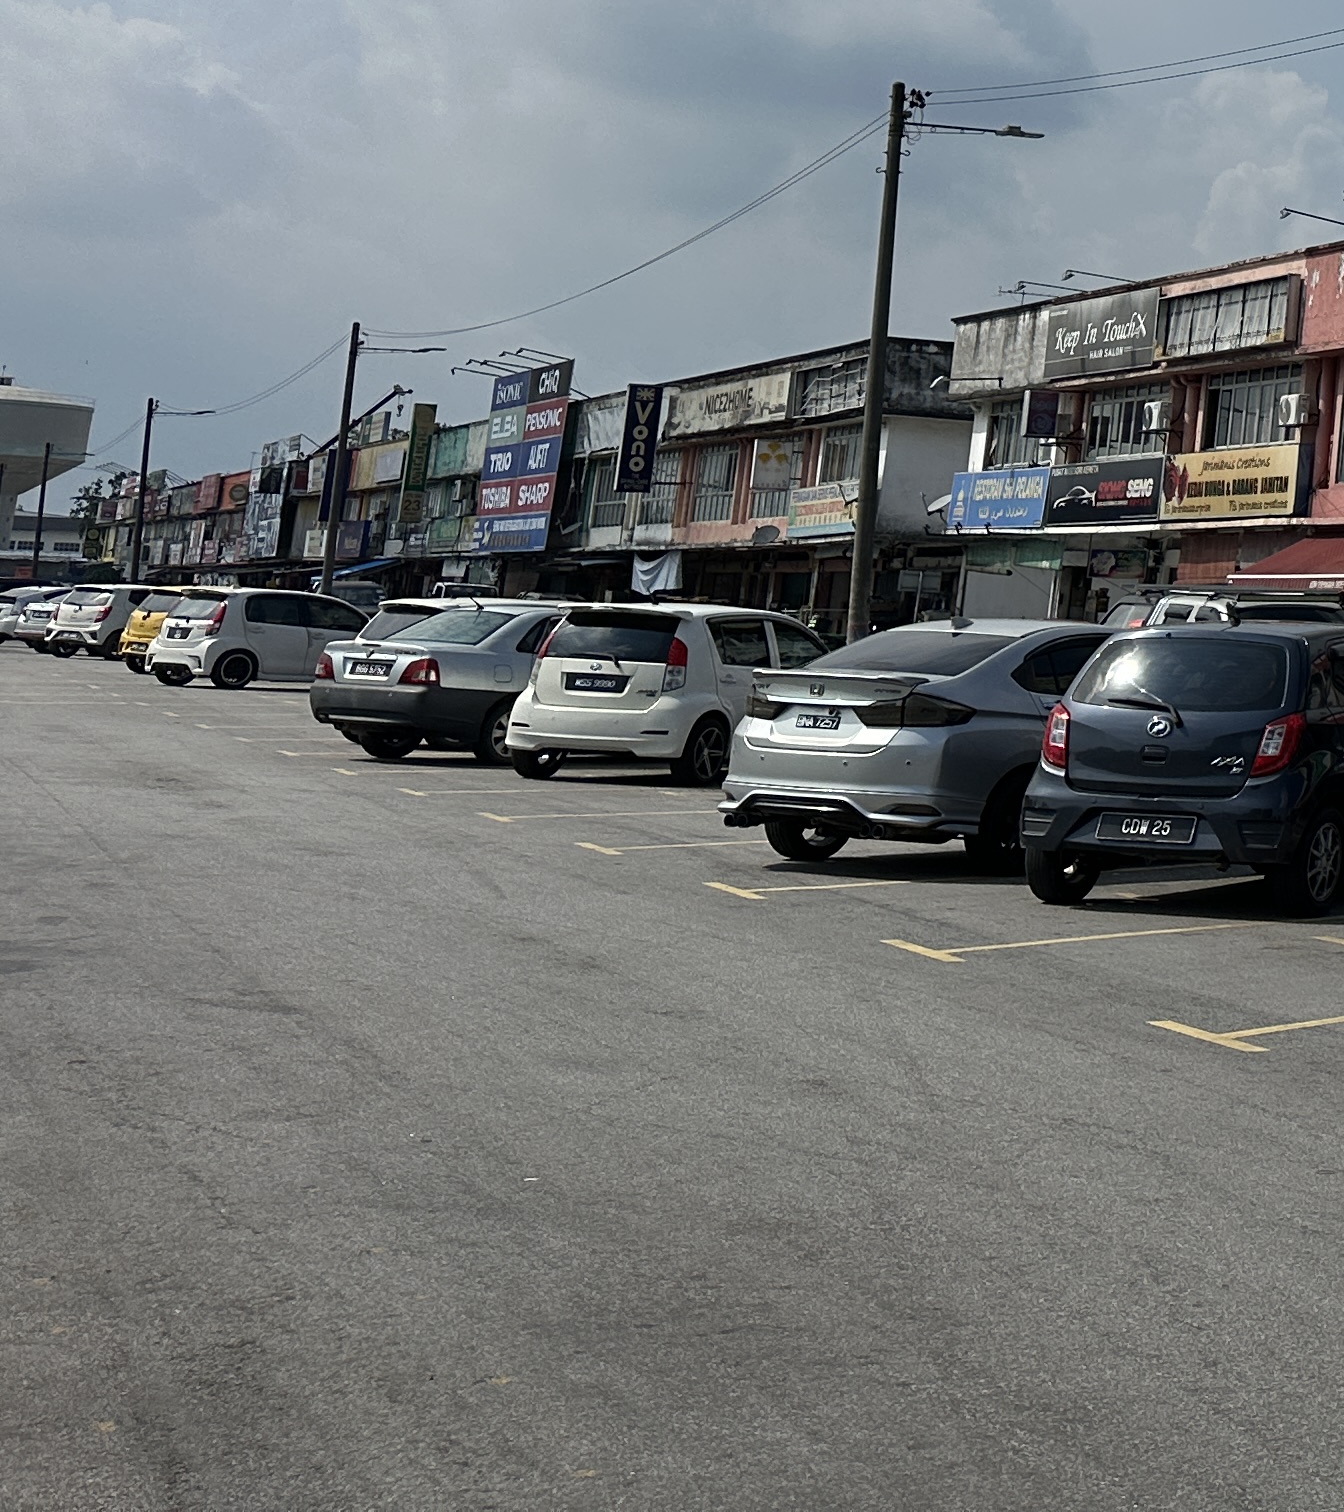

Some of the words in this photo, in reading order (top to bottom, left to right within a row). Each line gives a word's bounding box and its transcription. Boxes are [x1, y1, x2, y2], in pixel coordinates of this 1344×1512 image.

[1055, 328, 1080, 355] Keep
[1083, 323, 1097, 345] In
[1102, 312, 1137, 342] Touch
[1103, 347, 1124, 358] SALON
[704, 387, 753, 415] NICE2HOME
[525, 407, 563, 432] PENSONIC
[629, 402, 654, 472] Vono
[489, 451, 512, 473] TRIO
[403, 499, 421, 511] 23
[481, 486, 510, 510] TOSHIBA
[517, 482, 549, 506] SHARP
[816, 717, 839, 728] 7257
[1121, 818, 1150, 835] CDW
[1151, 820, 1171, 835] 25
